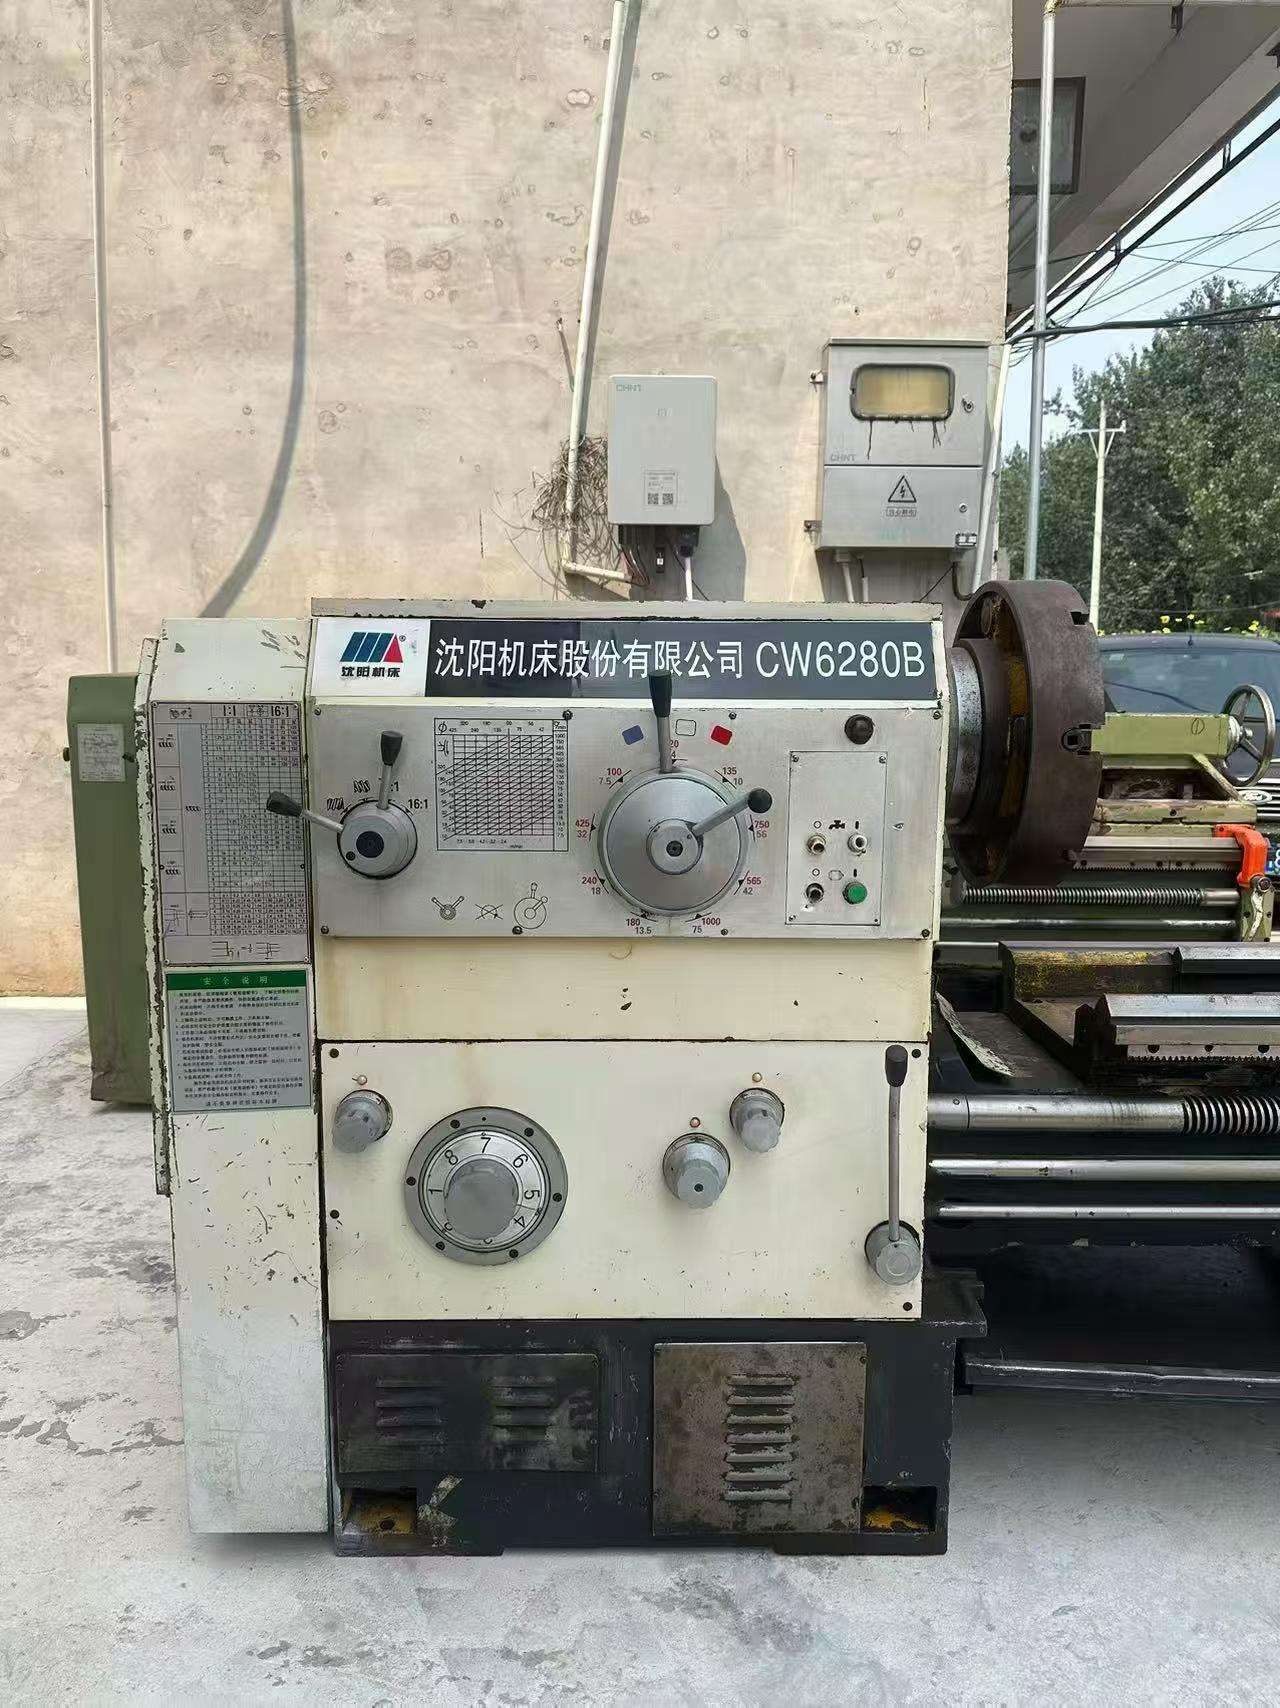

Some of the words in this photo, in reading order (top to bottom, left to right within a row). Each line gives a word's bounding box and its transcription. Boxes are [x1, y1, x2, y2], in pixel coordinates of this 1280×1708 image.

[434, 636, 743, 679] 沈阳机床股份有限公司
[756, 640, 926, 678] CW6280B
[341, 665, 401, 679] 沈阳机床
[271, 705, 290, 718] 16:1
[606, 767, 622, 776] 100
[722, 766, 738, 776] 135
[599, 777, 612, 786] 7.5
[733, 777, 743, 786] 10
[407, 798, 429, 810] 16:1
[575, 819, 590, 829] 425
[754, 820, 770, 829] 750
[577, 829, 588, 839] 32
[756, 829, 768, 839] 56
[581, 876, 598, 886] 240
[746, 876, 762, 886] 565
[591, 886, 601, 896] 18
[742, 886, 754, 896] 42
[625, 917, 641, 927] 180
[701, 917, 721, 927] 1000
[634, 925, 653, 935] 13.5
[691, 925, 703, 935] 75
[480, 1136, 492, 1153] 7
[444, 1149, 459, 1165] 8
[524, 1189, 540, 1200] 5
[513, 1215, 526, 1229] 4
